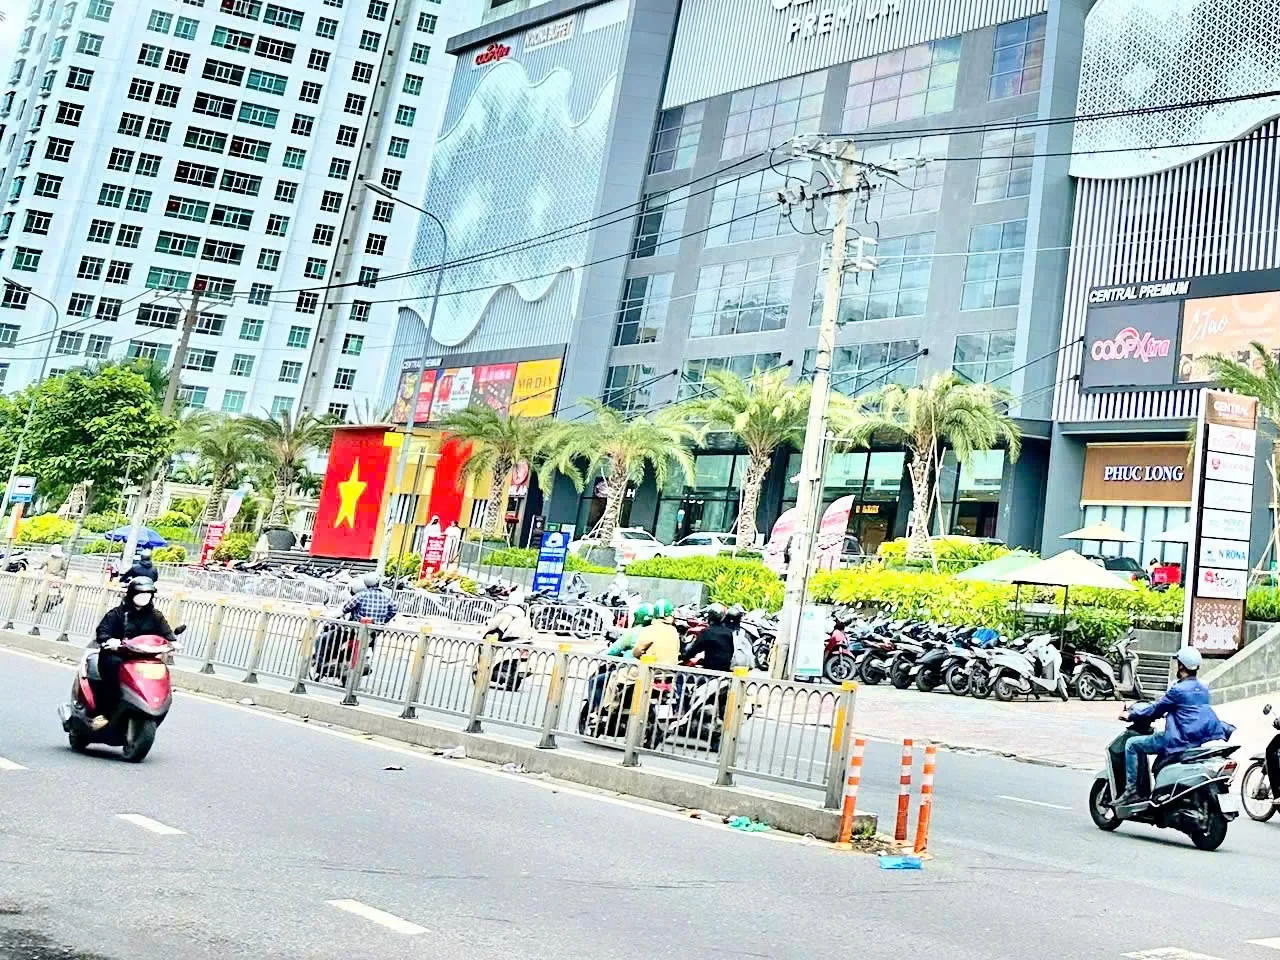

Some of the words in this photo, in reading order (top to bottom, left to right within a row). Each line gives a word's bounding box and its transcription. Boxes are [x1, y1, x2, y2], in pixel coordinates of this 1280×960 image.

[1089, 286, 1137, 303] CENTRAL
[1139, 281, 1190, 298] PREMIUM
[1103, 465, 1142, 482] PHUC
[1143, 465, 1184, 481] LONG
